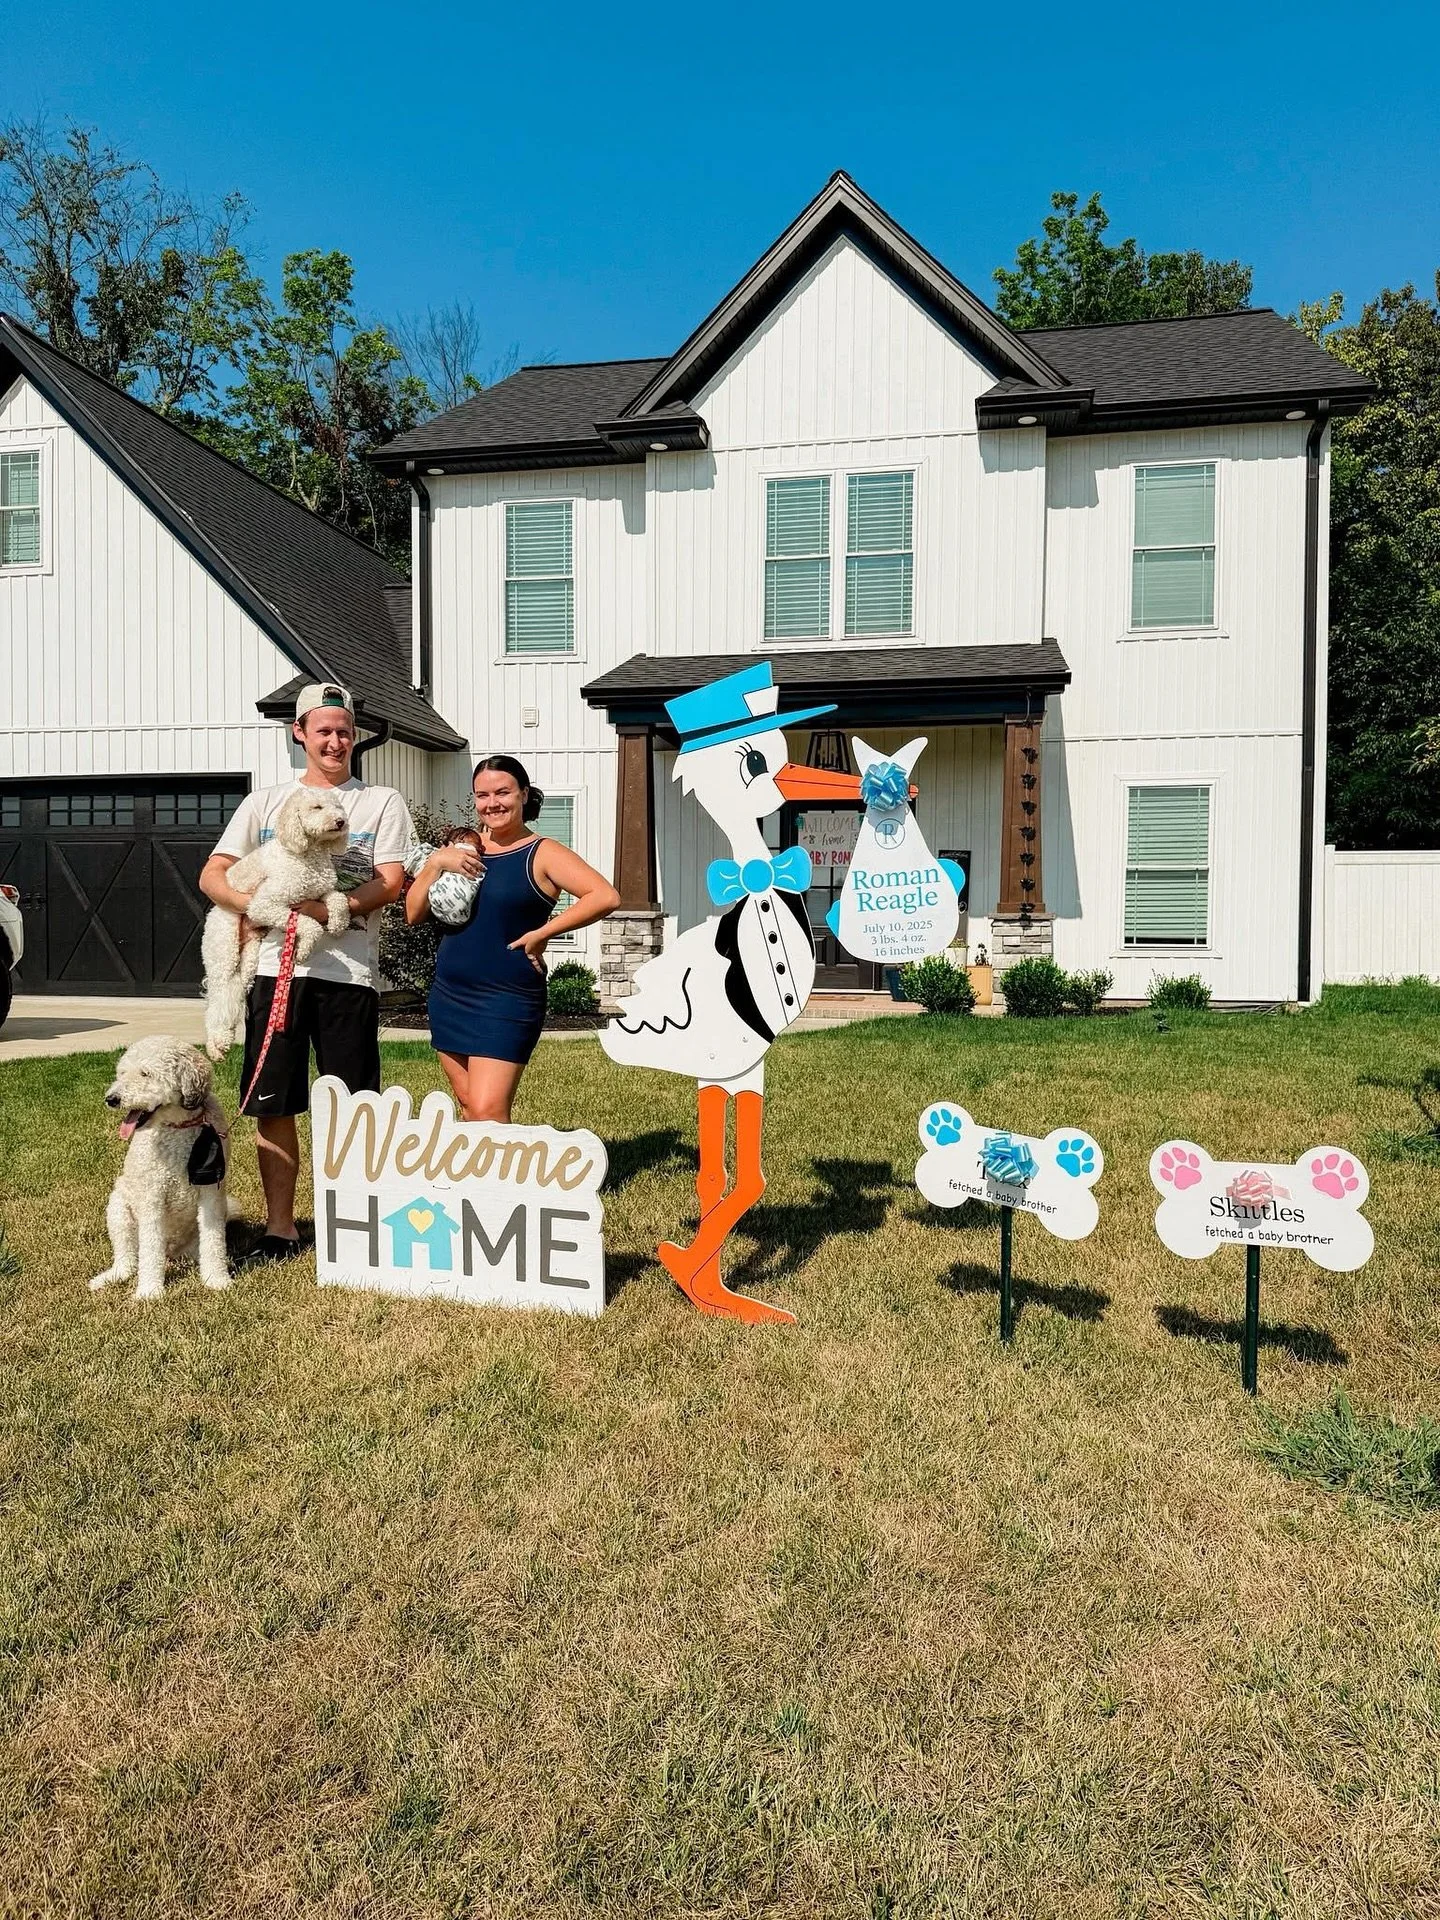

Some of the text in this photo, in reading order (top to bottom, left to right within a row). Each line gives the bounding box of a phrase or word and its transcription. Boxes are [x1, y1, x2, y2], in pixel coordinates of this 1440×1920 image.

[831, 851, 853, 865] ROM
[852, 867, 940, 890] Roman
[857, 887, 938, 914] Reagle
[863, 923, 885, 934] July
[907, 920, 933, 930] 2025
[871, 936, 877, 944] 3
[880, 934, 898, 944] lbs.
[901, 934, 907, 942] 4
[875, 945, 925, 956] 16 inches
[324, 1086, 593, 1191] Welcome
[949, 1179, 1058, 1215] fetched a baby brother
[1210, 1196, 1305, 1223] Skittles
[326, 1189, 590, 1289] HME
[1205, 1225, 1243, 1239] fetched
[1248, 1231, 1254, 1239] a
[1259, 1230, 1283, 1243] baby
